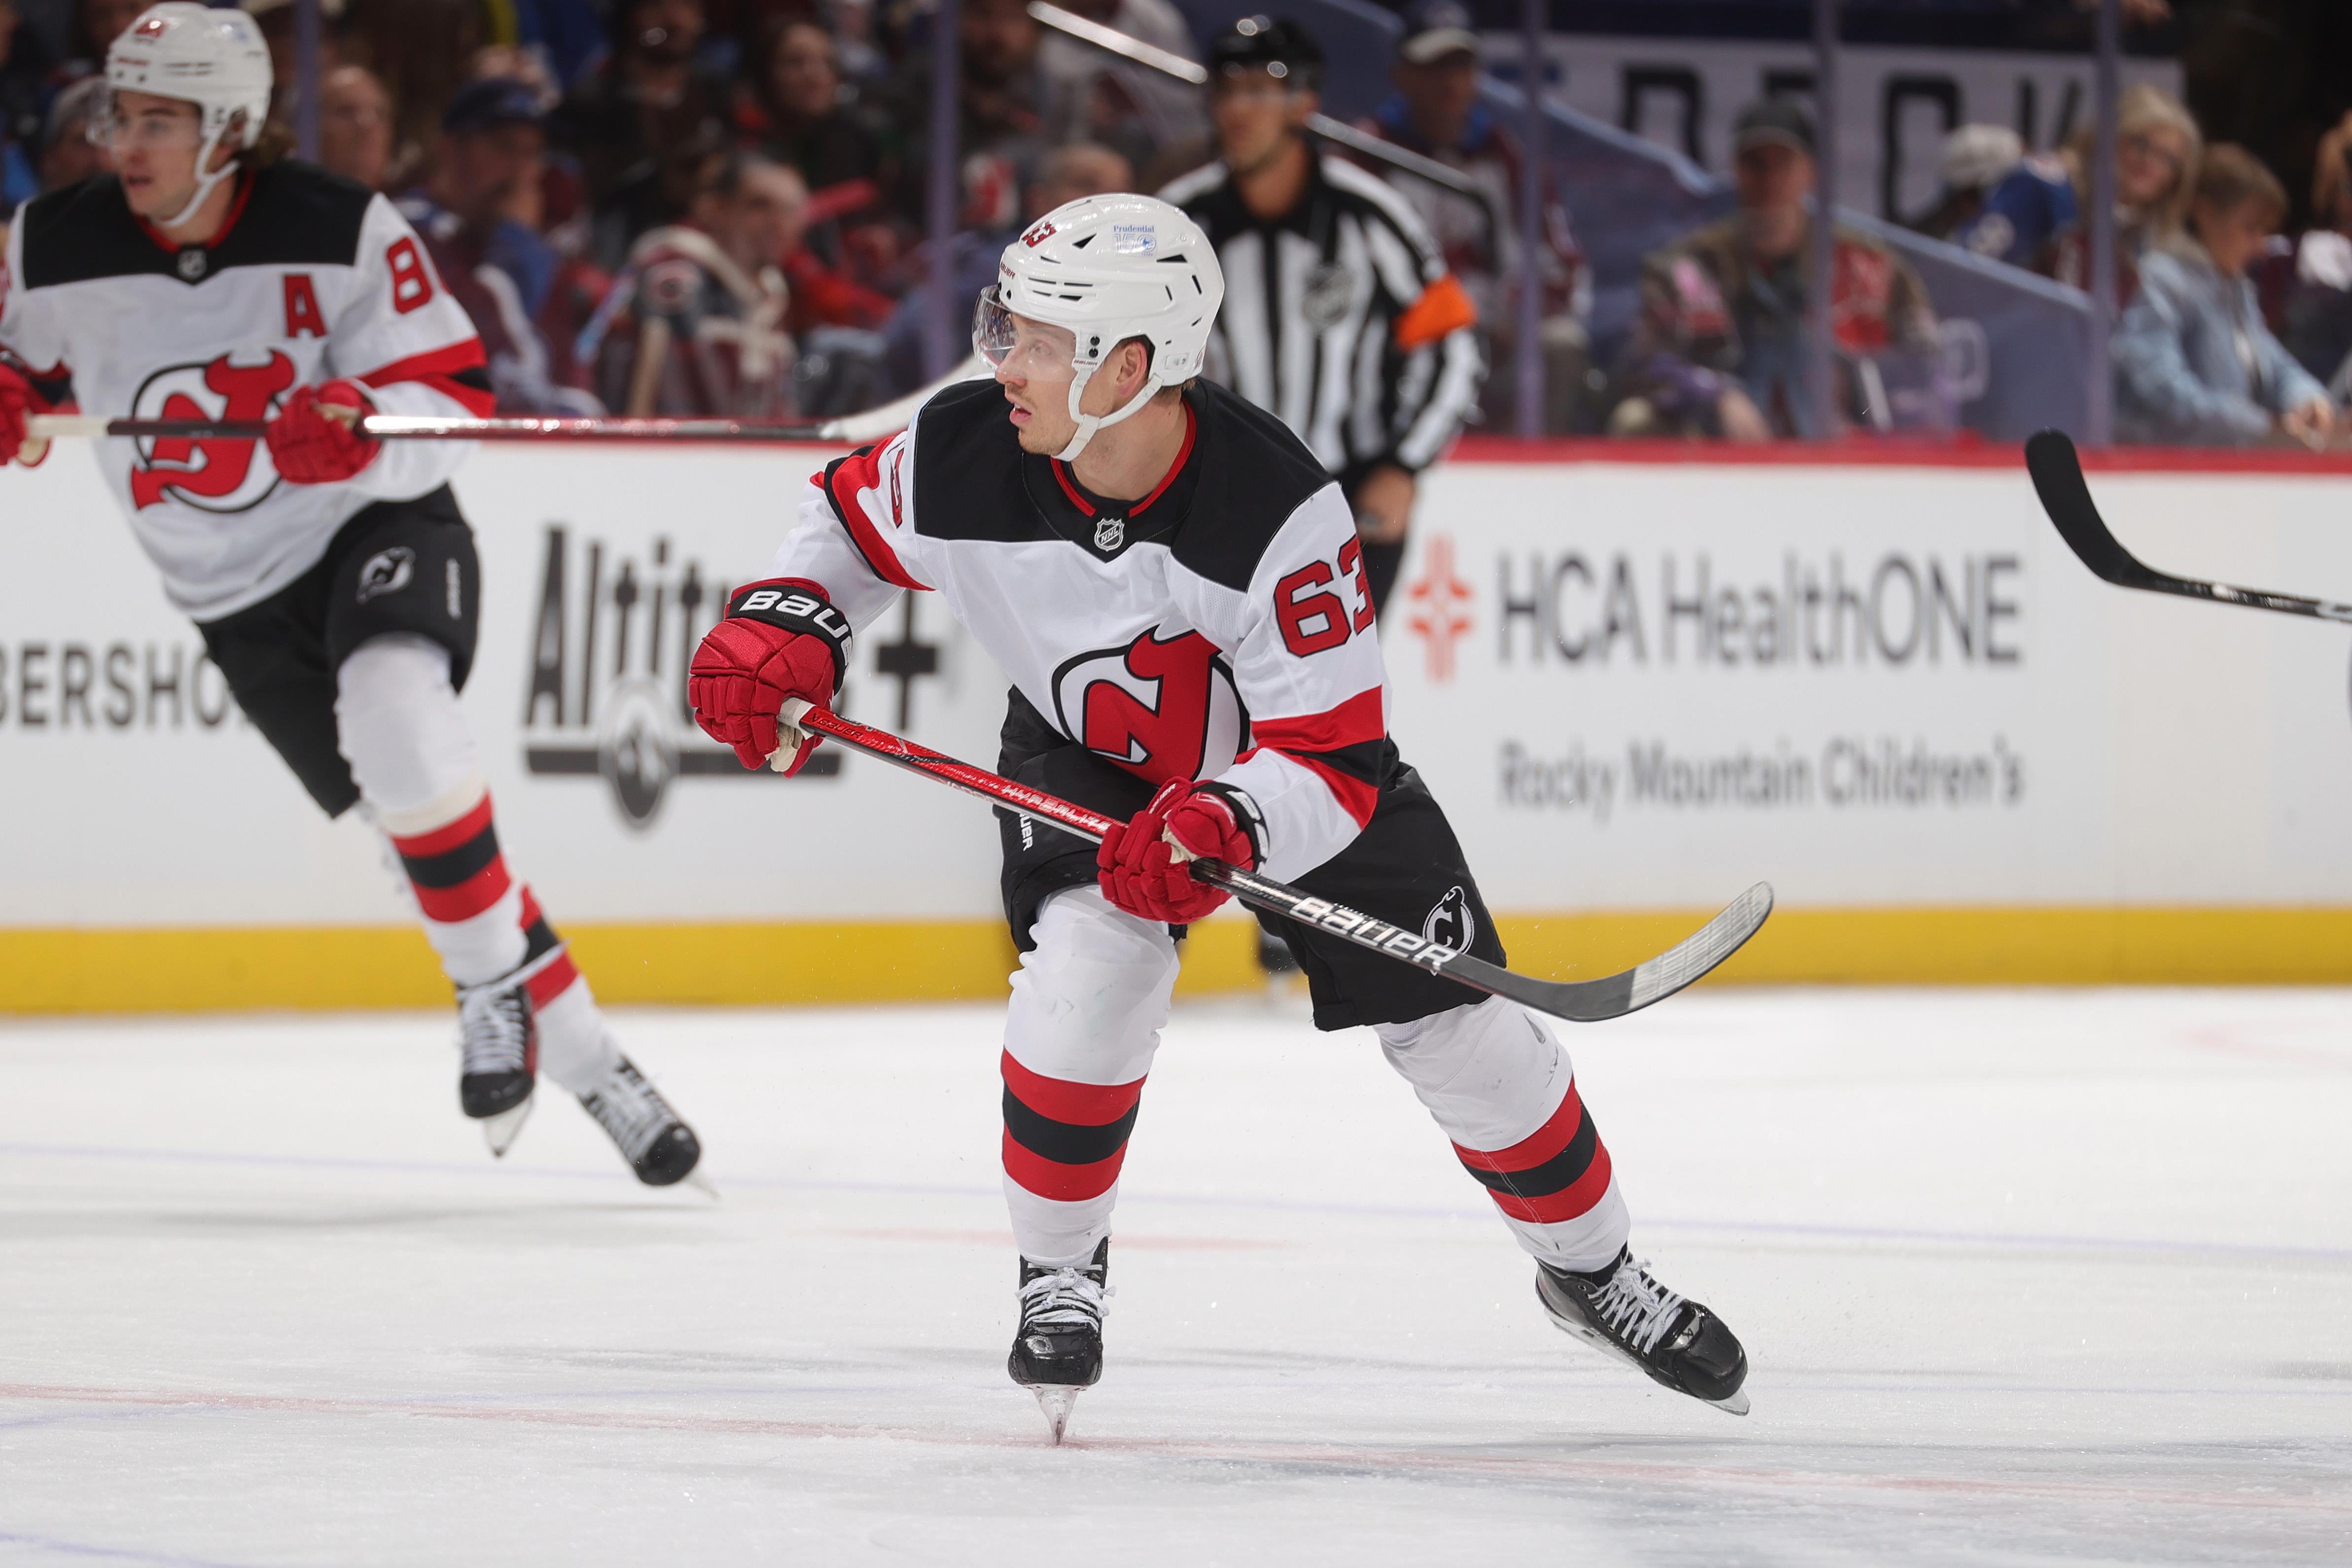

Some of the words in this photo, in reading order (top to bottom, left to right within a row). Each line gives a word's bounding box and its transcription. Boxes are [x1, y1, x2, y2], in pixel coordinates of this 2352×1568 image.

[282, 273, 328, 338] A
[385, 235, 436, 316] 8
[1000, 261, 1016, 280] AUER
[1101, 527, 1119, 543] NHL
[739, 591, 853, 677] BAUE
[1273, 533, 1375, 658] 63
[1498, 552, 1647, 664] HCA
[1662, 548, 2022, 664] HealthONE
[0, 642, 248, 731] ERSHO
[1500, 741, 1616, 822] Rocky
[1629, 741, 1812, 806] Mountain
[1822, 739, 2025, 807] Children's
[1019, 813, 1034, 852] UER
[1288, 896, 1458, 971] BAUER
